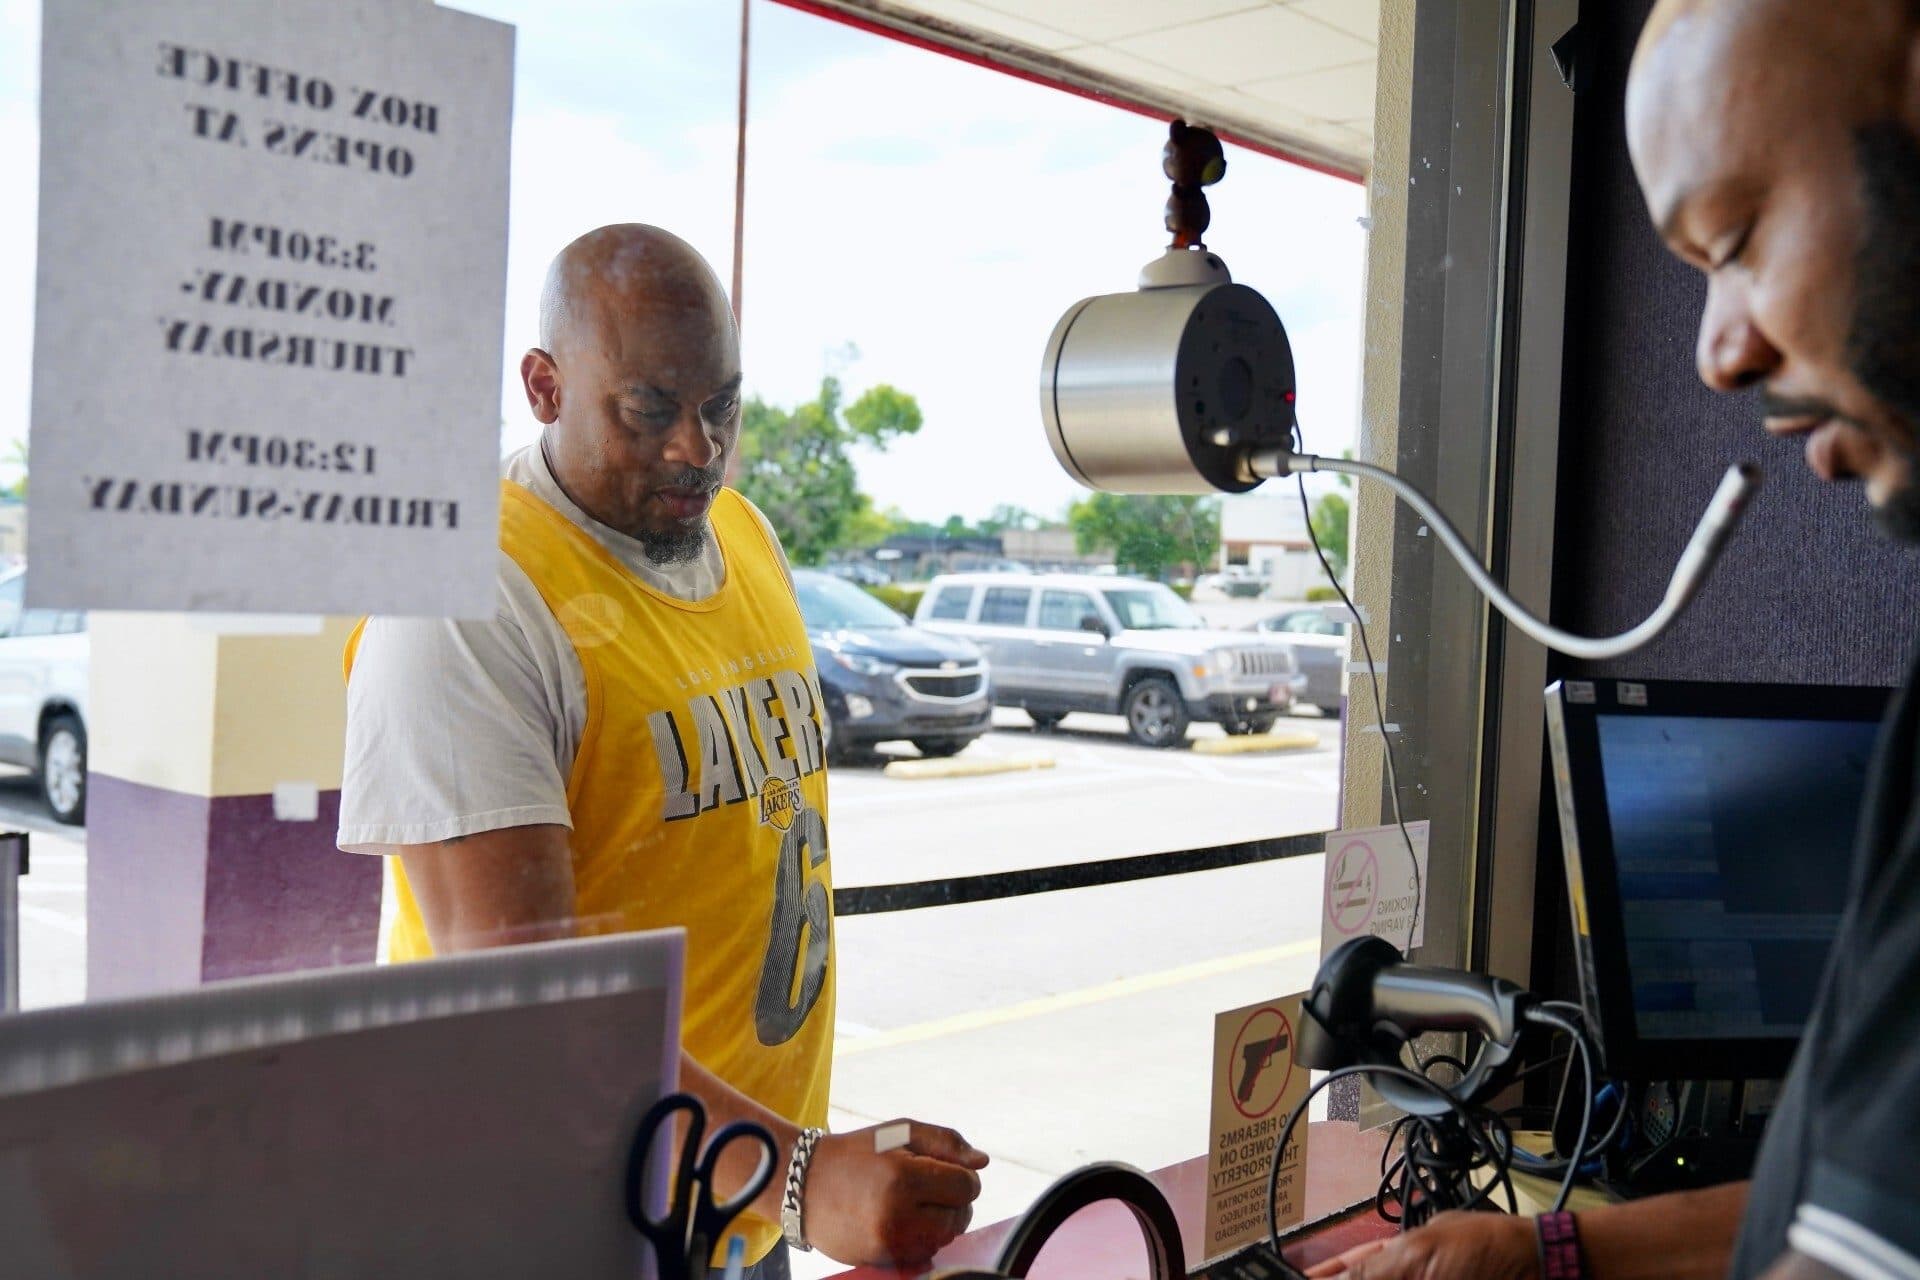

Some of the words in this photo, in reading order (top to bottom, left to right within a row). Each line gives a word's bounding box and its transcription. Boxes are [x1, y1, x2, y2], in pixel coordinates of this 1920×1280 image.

[676, 668, 712, 689] LOS
[760, 788, 800, 823] LAKERS
[755, 807, 829, 1046] 6
